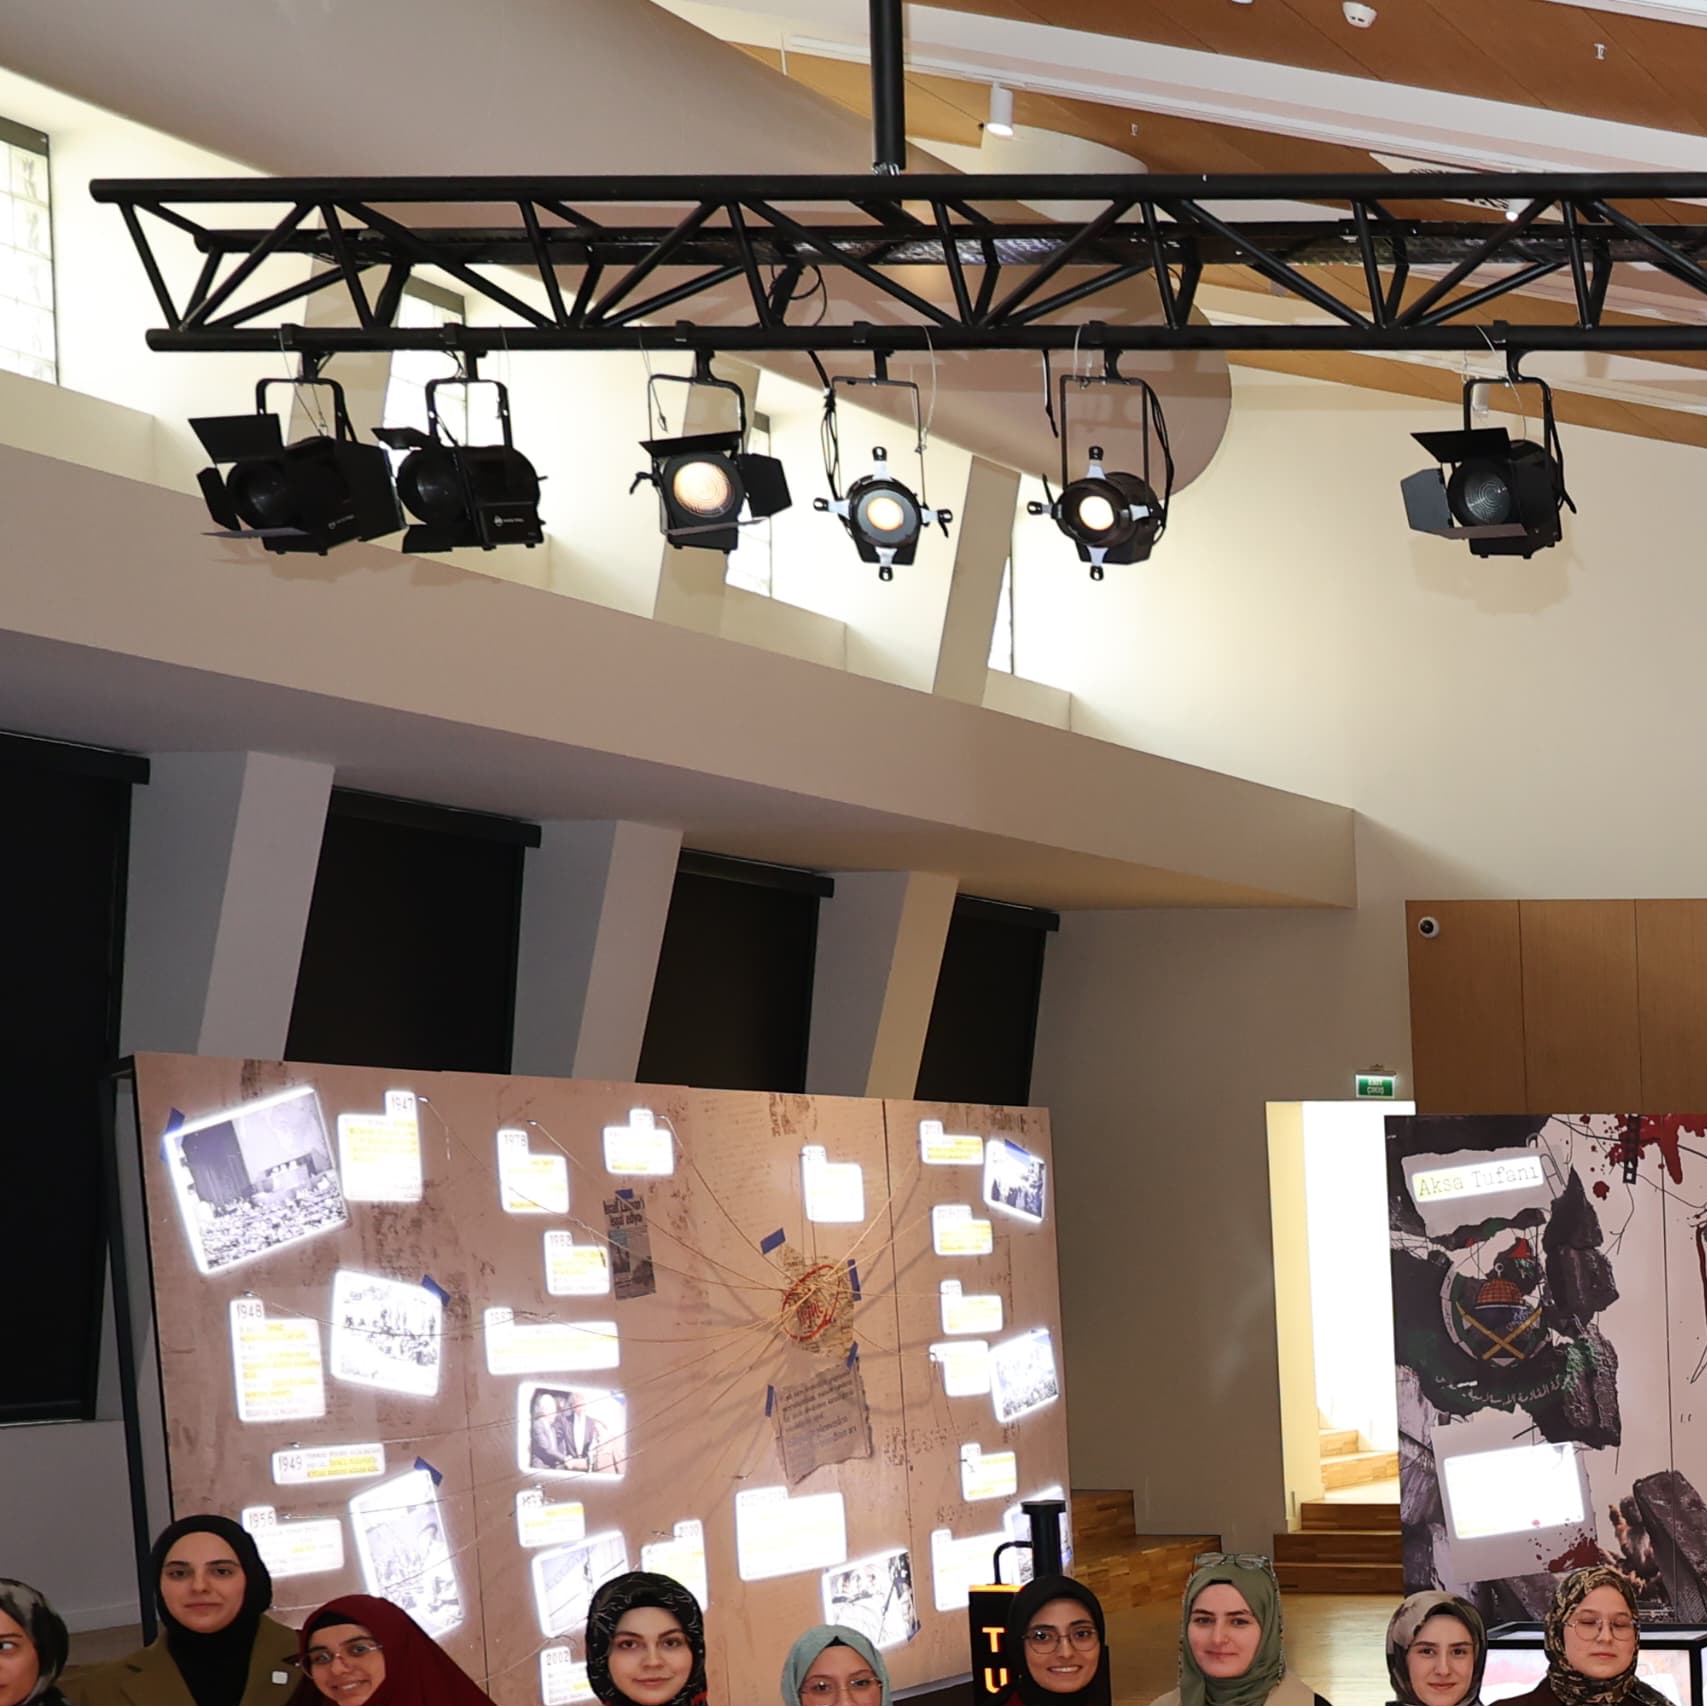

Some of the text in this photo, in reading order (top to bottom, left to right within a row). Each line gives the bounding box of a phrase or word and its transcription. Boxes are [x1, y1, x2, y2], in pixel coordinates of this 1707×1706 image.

[391, 1095, 415, 1112] 1947
[1419, 1166, 1539, 1196] Aksa Tufanı
[237, 1303, 263, 1319] 1948
[278, 1455, 303, 1472] 1949
[249, 1511, 274, 1529] 1956
